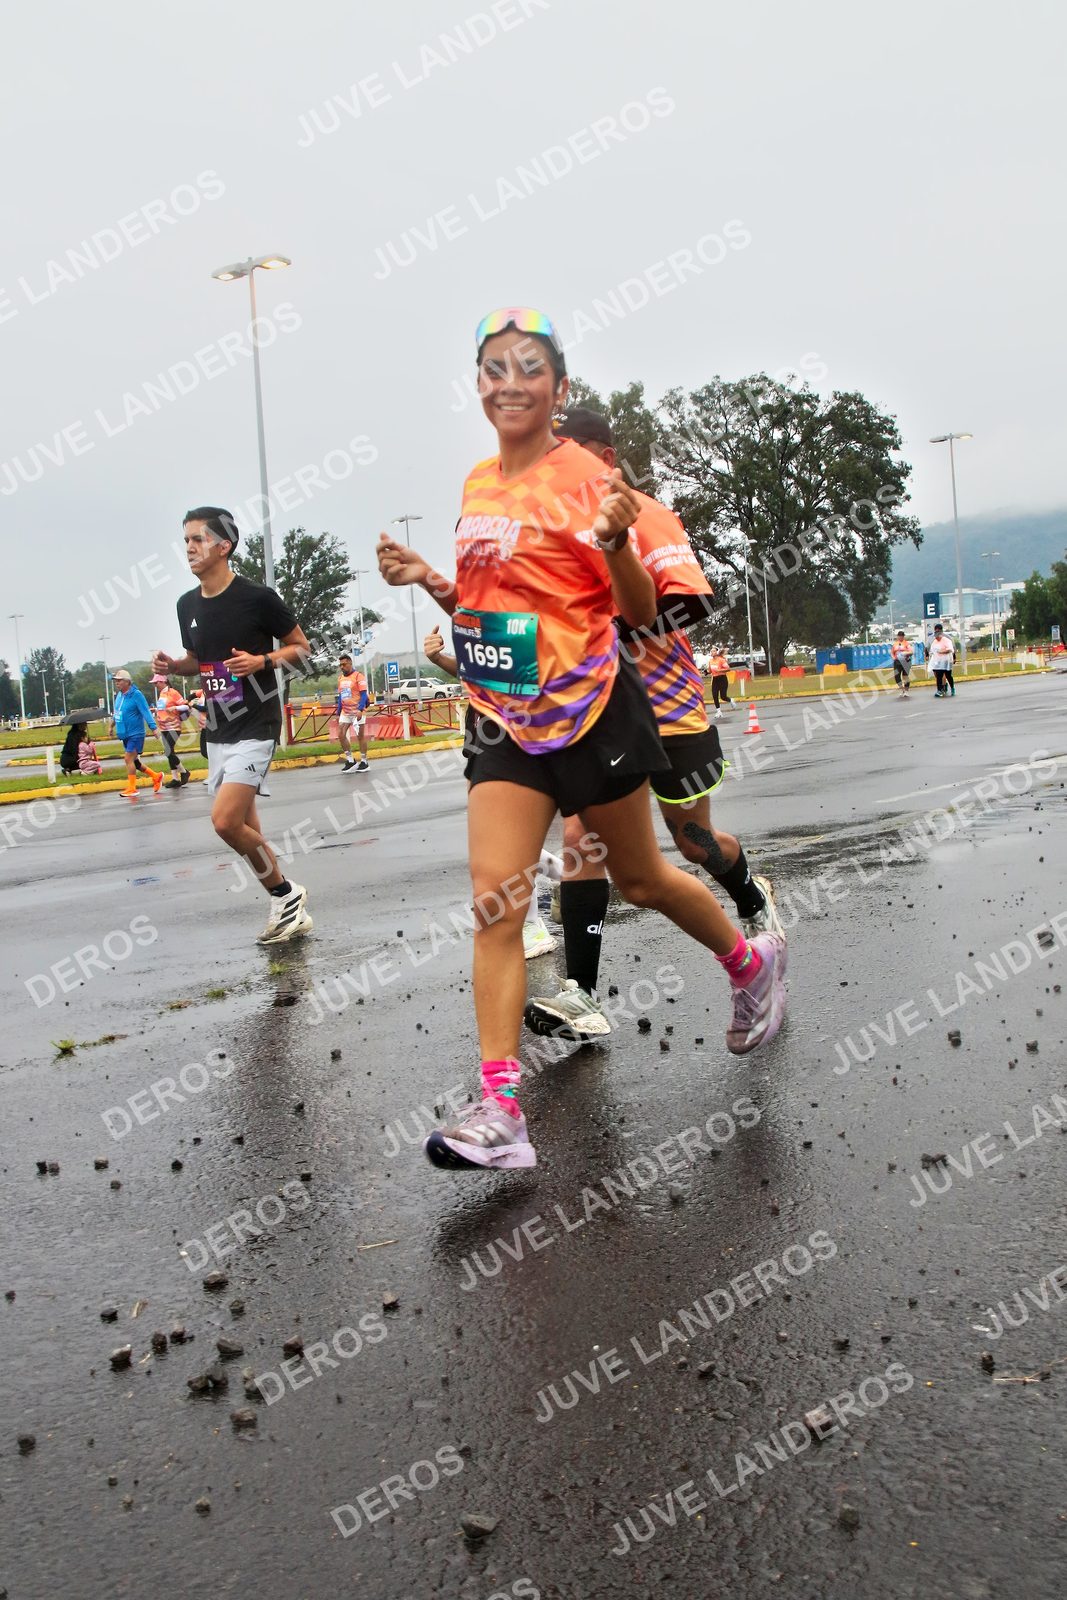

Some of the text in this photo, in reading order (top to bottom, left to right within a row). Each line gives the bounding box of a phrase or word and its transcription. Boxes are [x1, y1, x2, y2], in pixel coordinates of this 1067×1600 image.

[927, 603, 936, 615] E
[506, 618, 529, 635] 10K
[464, 642, 514, 670] 1695
[206, 678, 227, 691] 132
